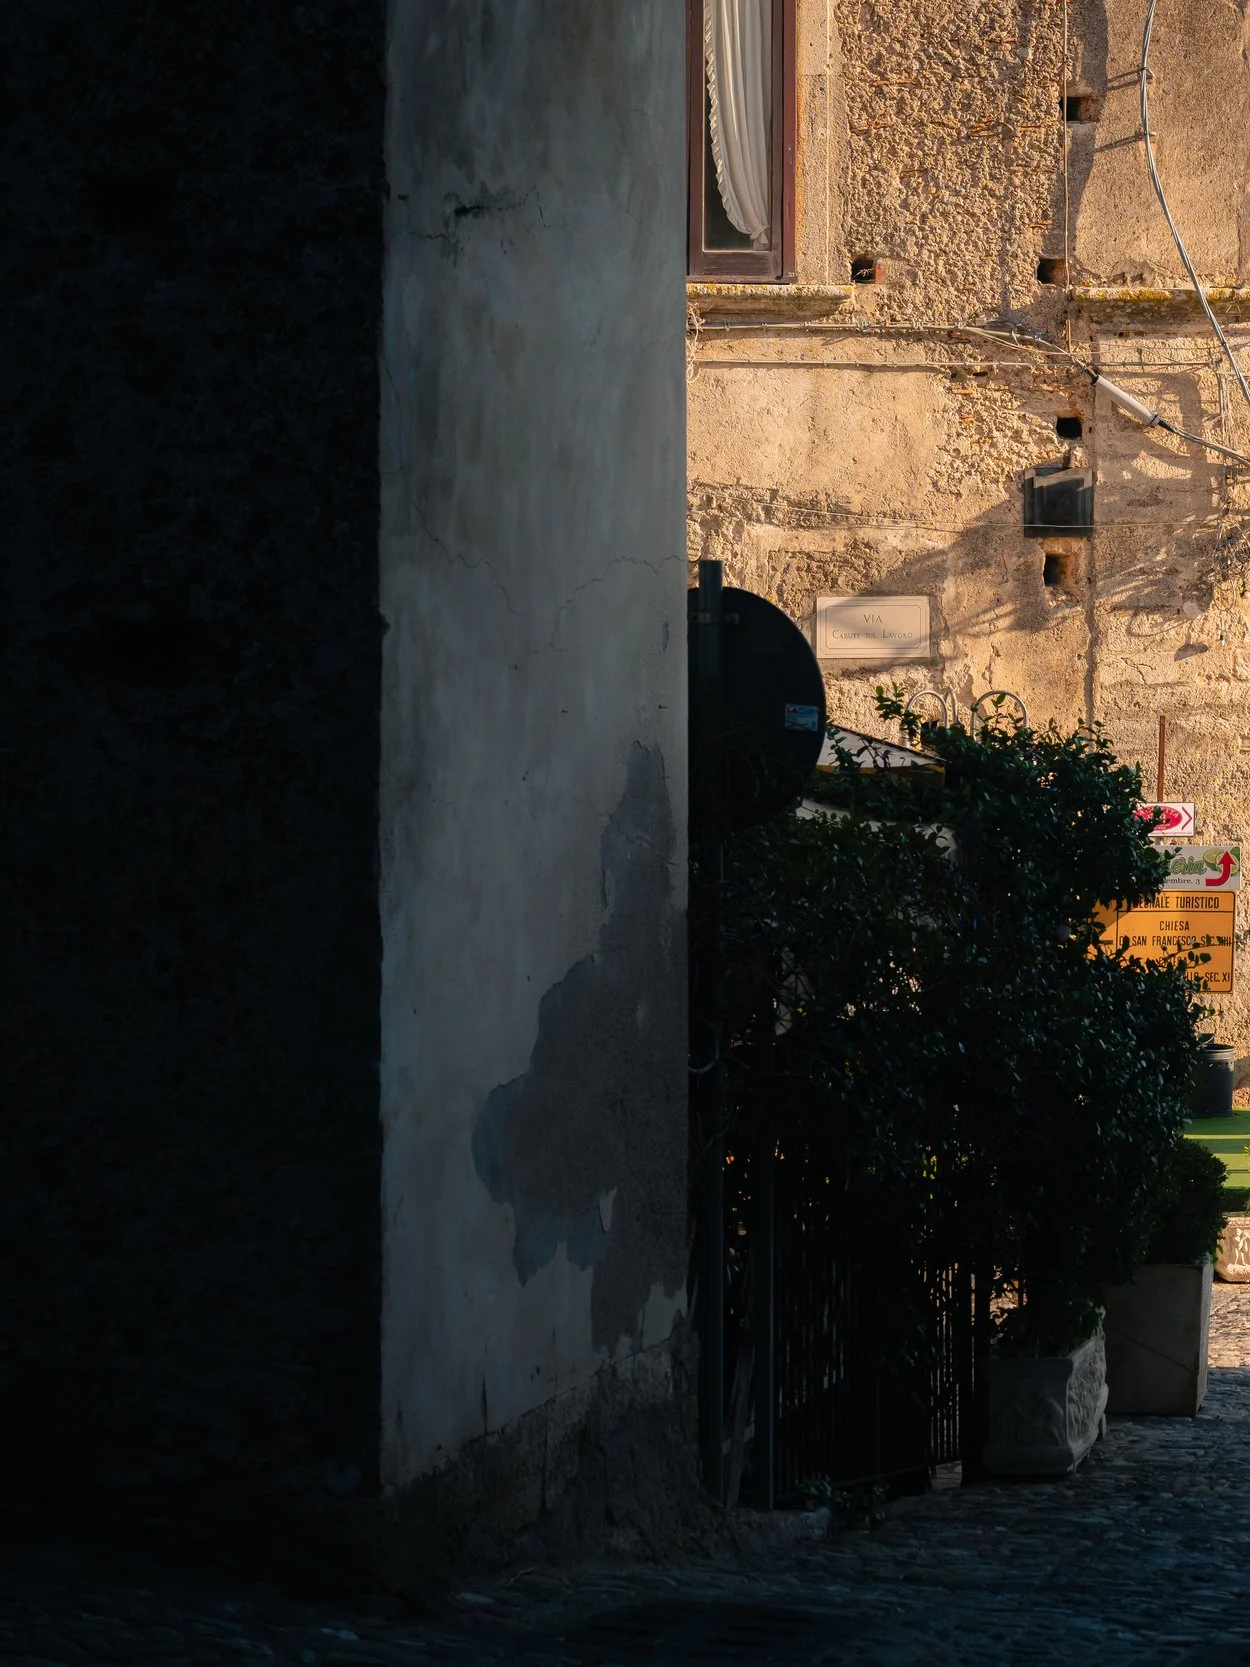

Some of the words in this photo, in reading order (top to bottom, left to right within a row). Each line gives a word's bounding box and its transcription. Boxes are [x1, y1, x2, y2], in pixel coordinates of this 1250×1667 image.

[863, 614, 883, 624] VIA
[1175, 896, 1220, 909] TURISTICO
[1159, 920, 1190, 931] CHIESA
[1132, 935, 1147, 946] SAN
[1204, 971, 1220, 982] SEC.
[1222, 972, 1230, 982] XI
